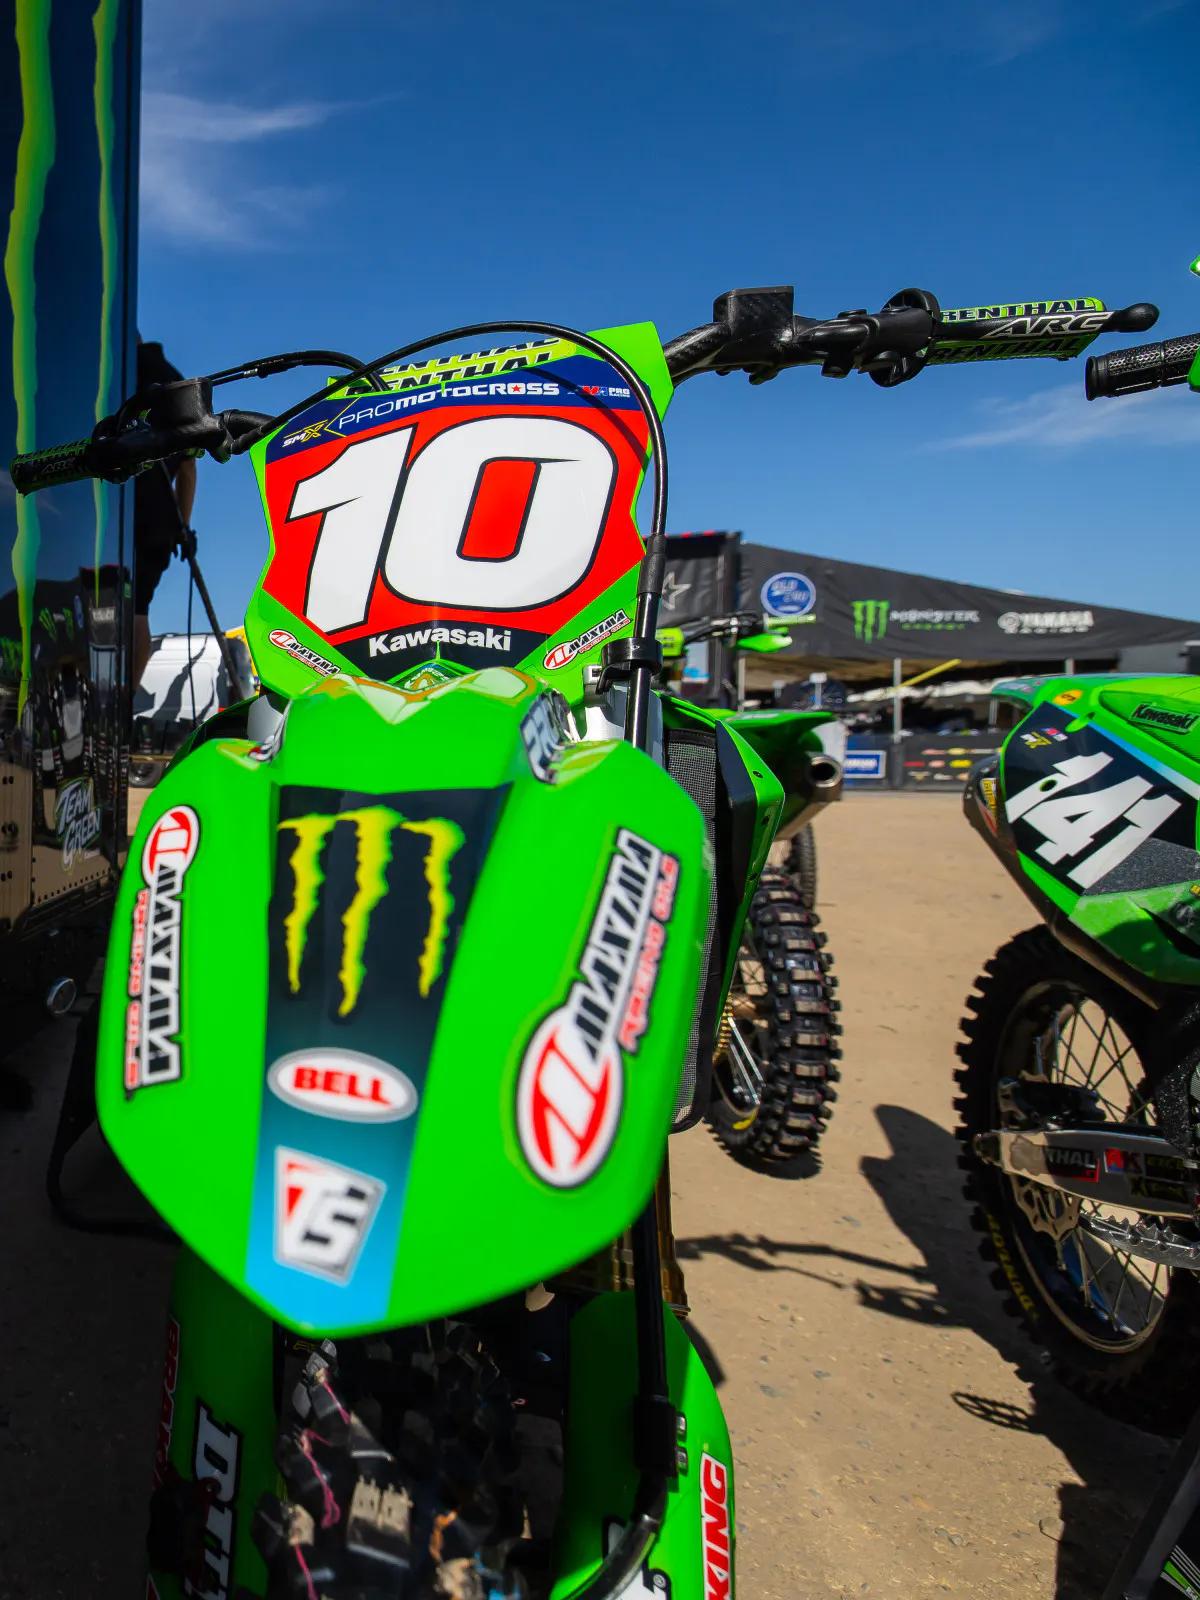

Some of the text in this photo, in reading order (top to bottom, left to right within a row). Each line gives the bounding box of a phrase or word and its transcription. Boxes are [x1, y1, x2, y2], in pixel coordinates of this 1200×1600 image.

[978, 312, 1115, 340] ARC
[286, 415, 617, 635] 10
[368, 627, 512, 658] Kawasaki
[1131, 703, 1199, 730] Kawasaki
[56, 780, 92, 835] TEAM
[1004, 751, 1182, 889] 141
[63, 807, 100, 866] GREEN
[293, 1066, 395, 1110] BELL
